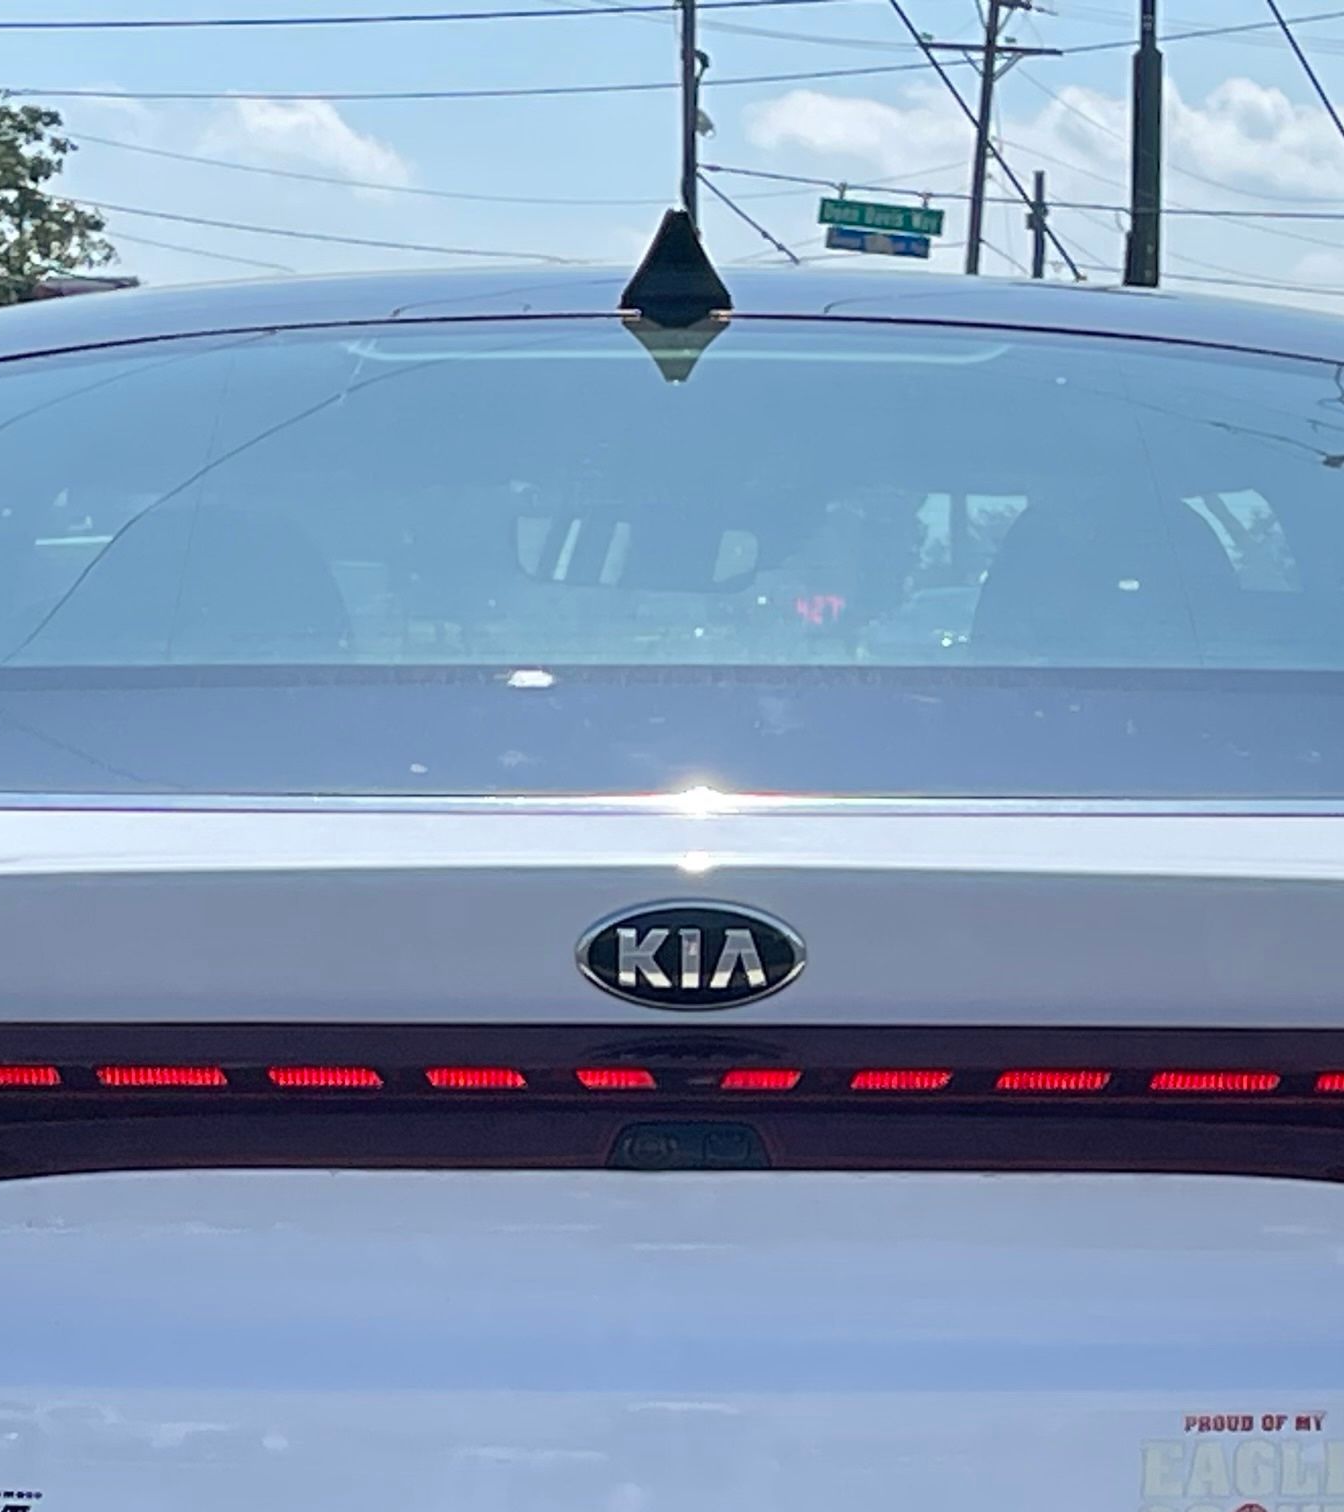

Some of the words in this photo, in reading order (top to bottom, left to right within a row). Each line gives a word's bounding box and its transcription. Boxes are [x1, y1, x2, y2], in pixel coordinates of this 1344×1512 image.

[616, 928, 767, 989] KIA
[1184, 1414, 1255, 1433] PROUD
[1261, 1413, 1288, 1432] OF
[1295, 1410, 1327, 1432] MY
